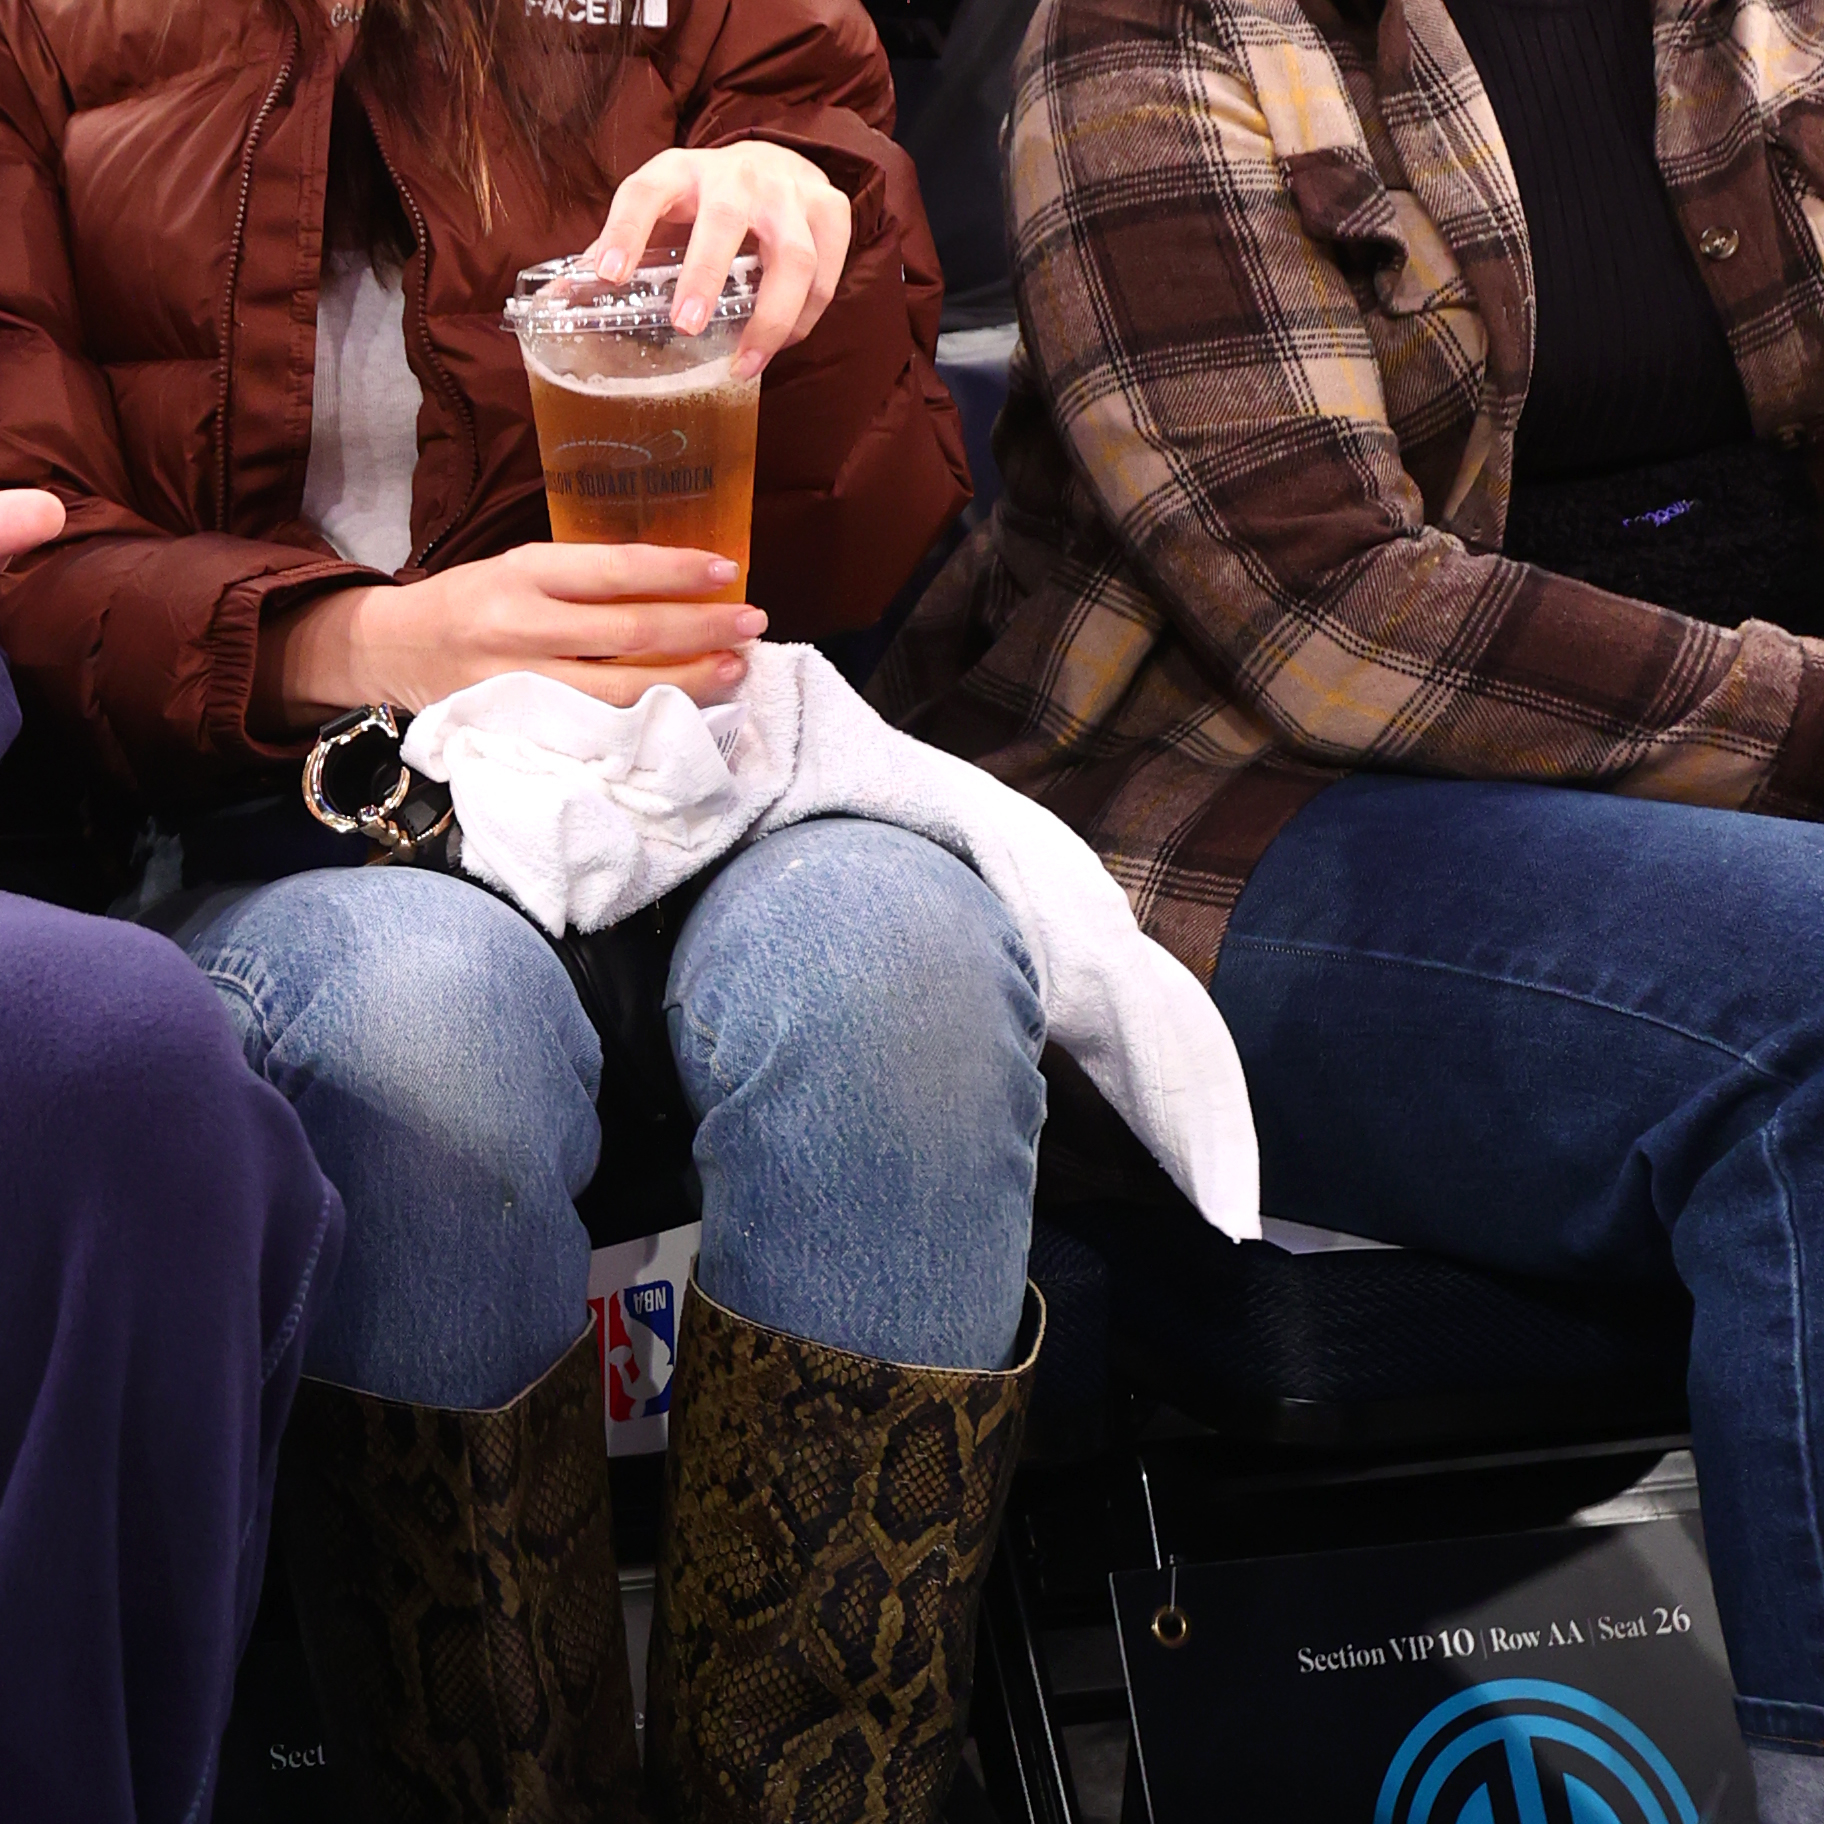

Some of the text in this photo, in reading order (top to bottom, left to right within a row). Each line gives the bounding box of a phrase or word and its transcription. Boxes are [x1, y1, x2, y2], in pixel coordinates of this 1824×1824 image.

[645, 466, 713, 494] GARDEN
[634, 1287, 667, 1314] NBA
[1297, 1604, 1692, 1673] Section VIP 10 Row AA Seat 26
